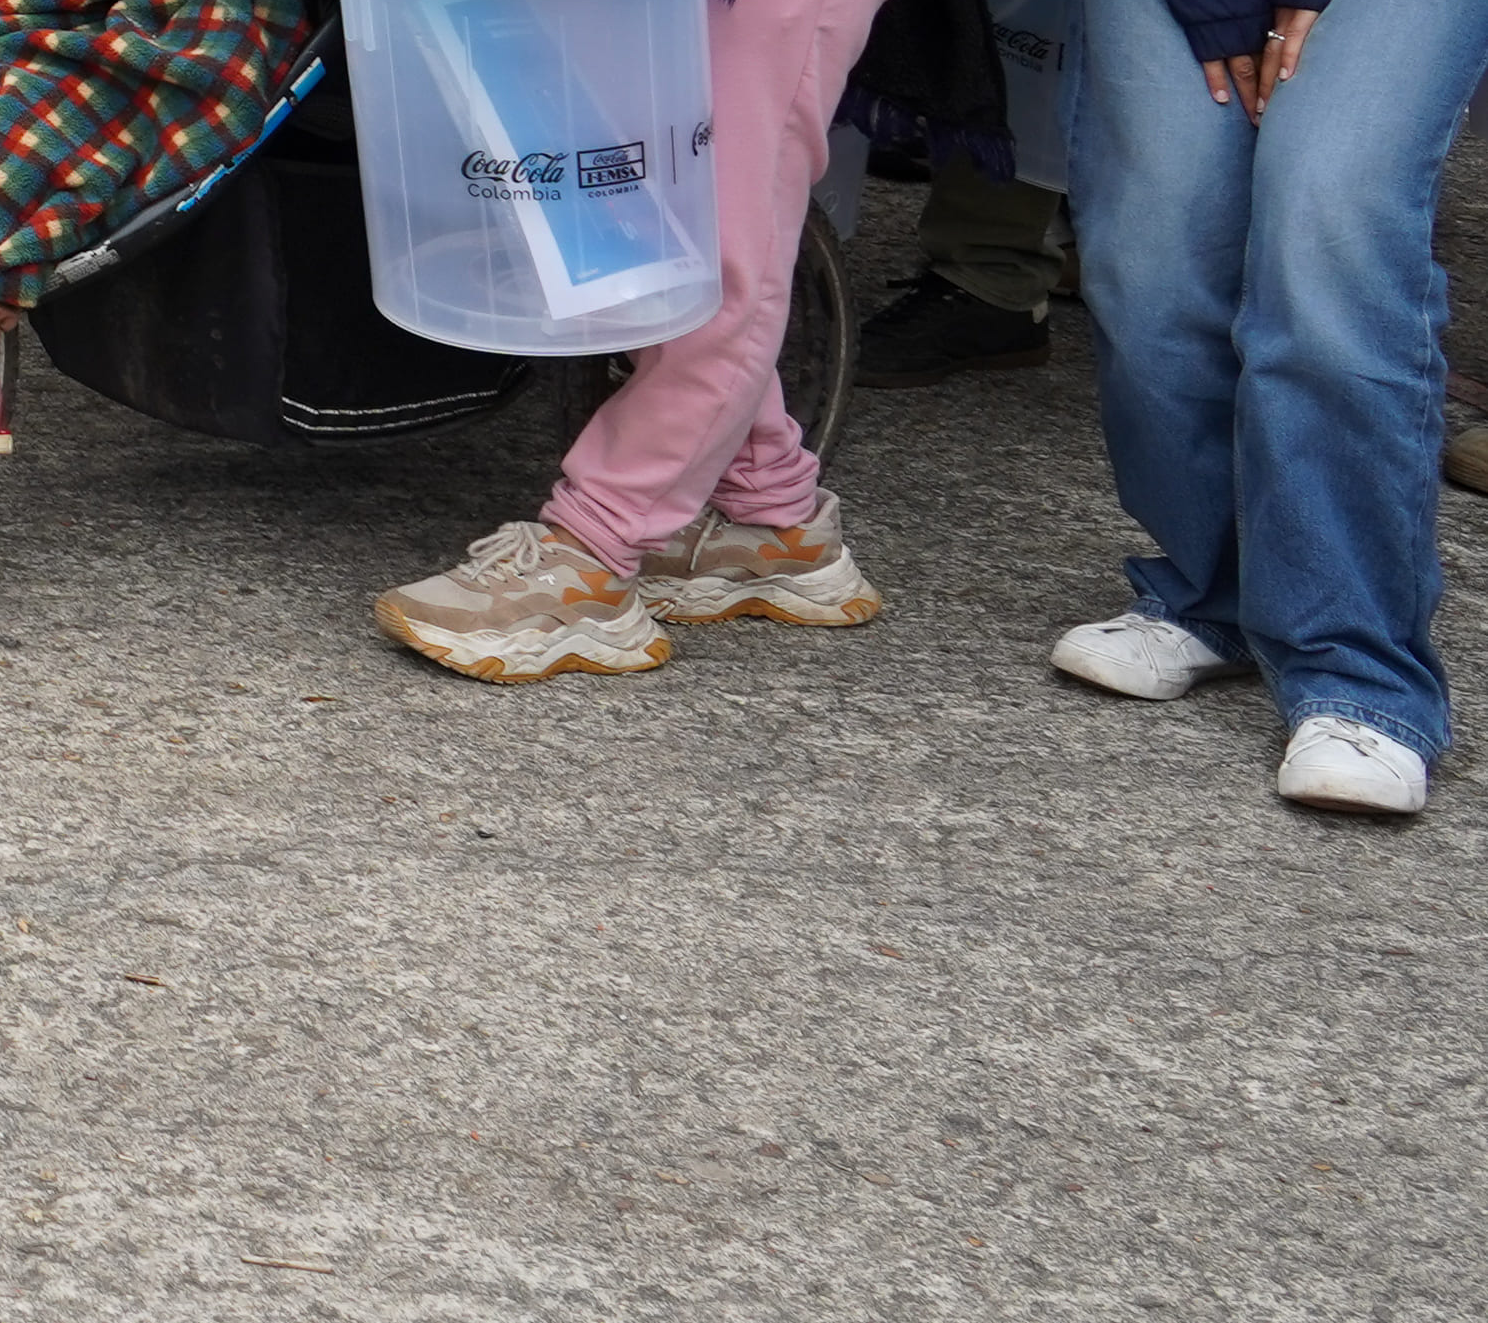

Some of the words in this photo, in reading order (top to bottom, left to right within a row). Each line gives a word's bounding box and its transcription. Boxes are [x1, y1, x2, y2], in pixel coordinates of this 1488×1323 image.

[461, 150, 571, 184] Coca-Cola
[586, 165, 639, 185] FEMSA
[467, 182, 562, 202] Colombia
[587, 184, 640, 199] COLOMBIA
